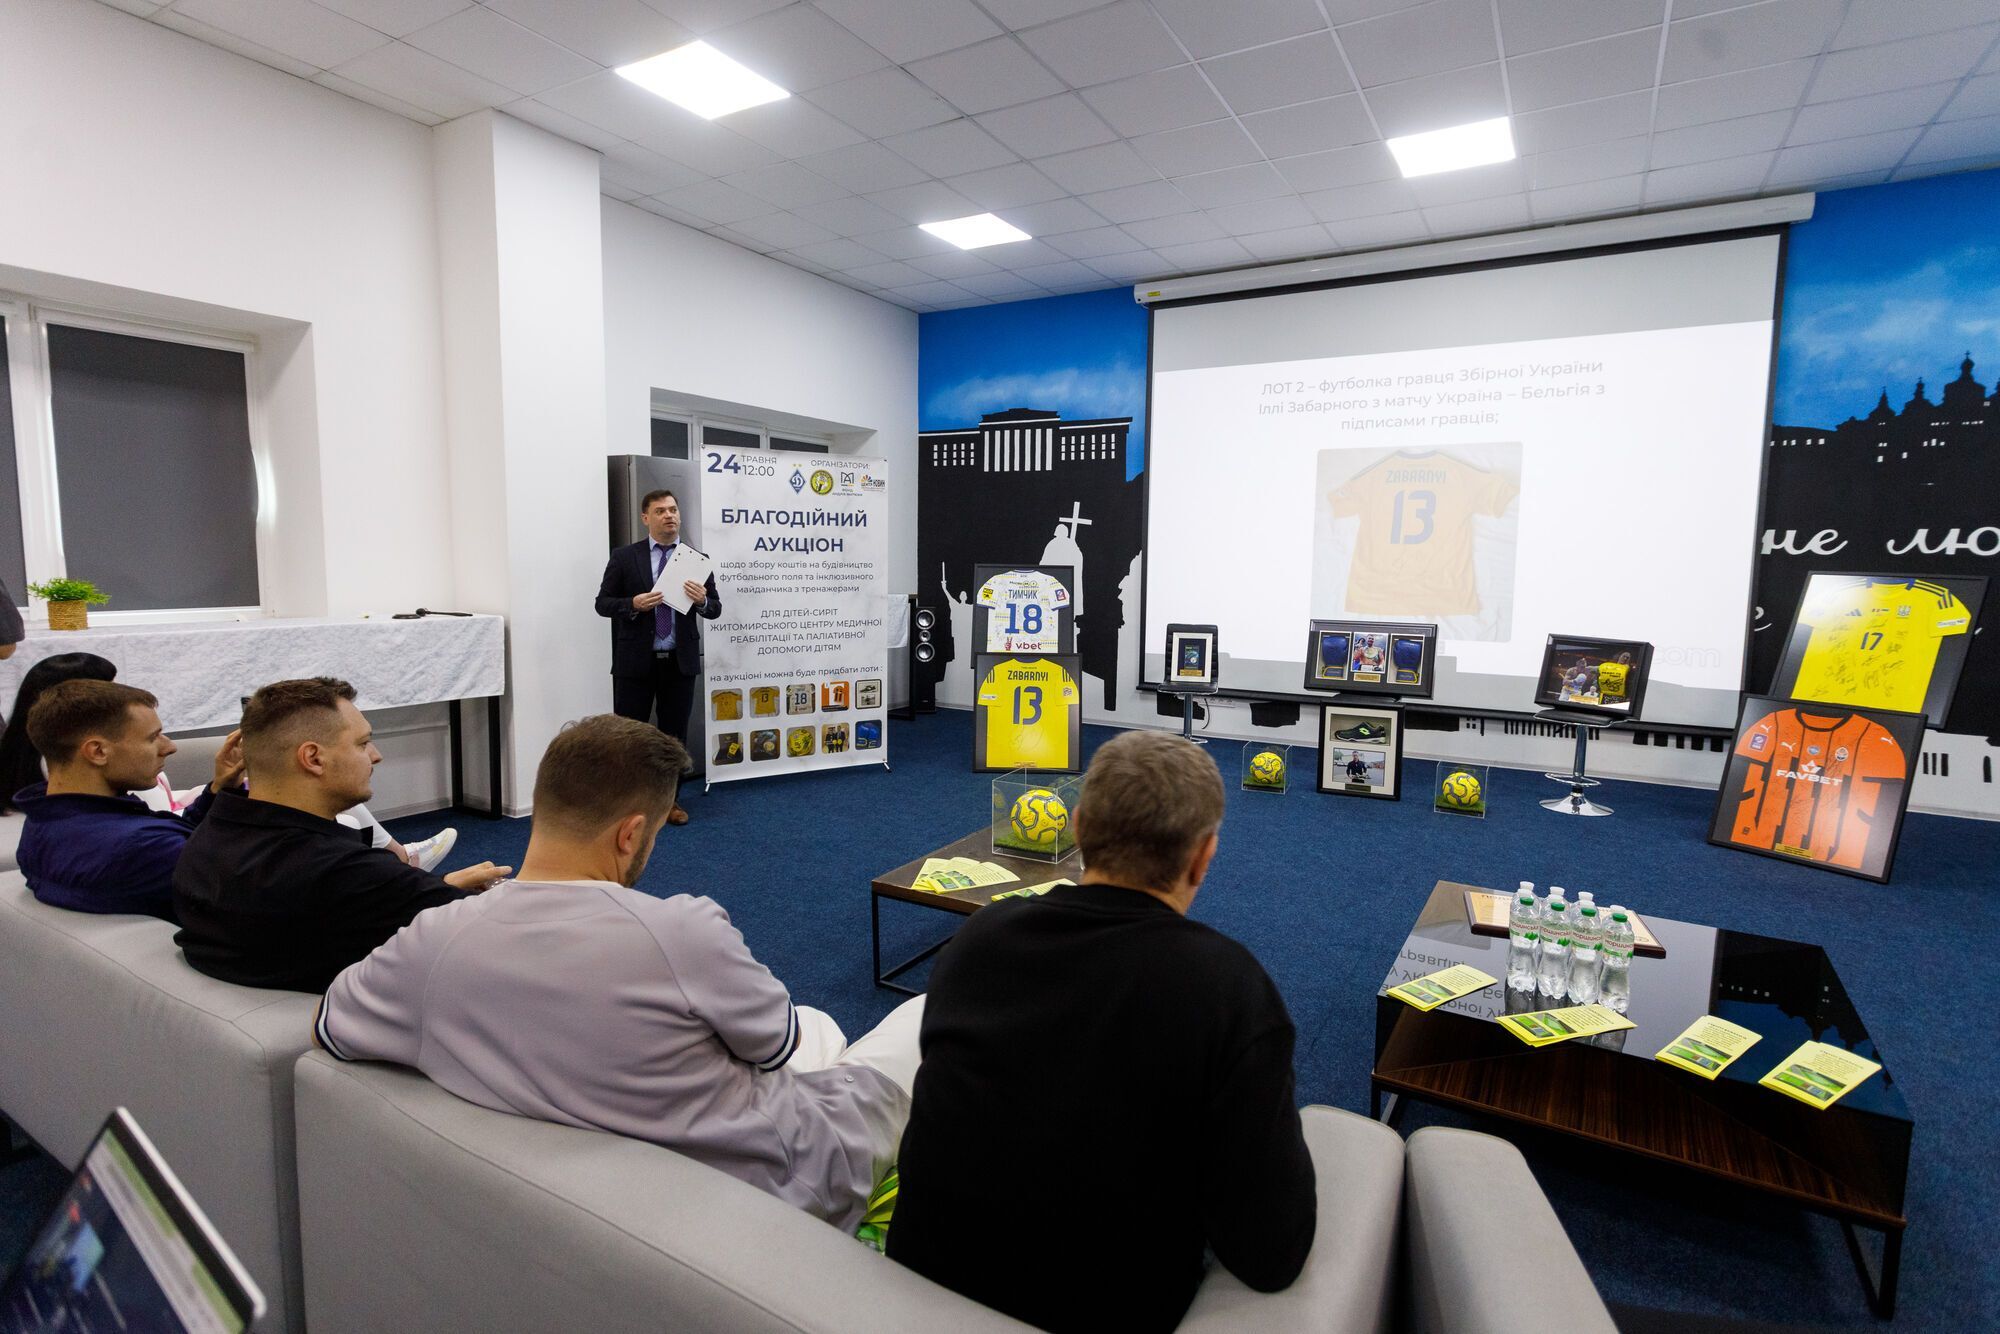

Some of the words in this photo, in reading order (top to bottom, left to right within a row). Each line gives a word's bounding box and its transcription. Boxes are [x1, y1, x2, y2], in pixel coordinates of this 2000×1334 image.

[1261, 382, 1292, 396] ЛОТ
[1296, 382, 1304, 392] 2
[1319, 375, 1392, 394] футболка
[1396, 371, 1454, 388] гравця
[1458, 366, 1524, 384] Збірної
[1529, 361, 1604, 379] України
[1258, 402, 1284, 416] Іллі
[1288, 396, 1368, 416] Забарного
[1372, 398, 1380, 409] з
[1385, 394, 1432, 411] матчу
[1436, 388, 1502, 407] Україна
[1522, 384, 1590, 400] Бельгія
[1596, 385, 1606, 396] з
[1340, 415, 1426, 432] підписами
[1430, 411, 1500, 428] гравців;
[707, 452, 740, 474] 24
[741, 455, 776, 464] ТРАВНЯ
[810, 460, 870, 470] ОРГАНІЗАТОРИ:
[742, 464, 774, 476] 12:00
[1385, 469, 1446, 485] ZABARNYI
[721, 508, 868, 528] БЛАГОДІЙНИЙ
[1390, 490, 1436, 545] 13
[754, 537, 844, 554] АУКЦІОН
[748, 560, 775, 570] збору
[778, 560, 807, 569] коштів
[822, 560, 874, 570] будівництво
[720, 572, 780, 582] футбольного
[816, 572, 874, 580] інклюзивного
[736, 586, 792, 594] майданчика
[802, 586, 860, 594] тренажерами
[1008, 589, 1038, 600] ТИМЧИК
[761, 610, 780, 618] ДЛЯ
[783, 608, 838, 618] ДІТЕЙ-СИРІТ
[1005, 604, 1042, 634] 18
[710, 622, 798, 632] ЖИТОМИРСЬКОГО
[800, 620, 834, 630] ЦЕНТРУ
[836, 618, 882, 628] МЕДИЧНОЇ
[730, 634, 790, 643] РЕАБІЛІТАЦІЇ
[806, 630, 866, 640] ПАЛІАТИВНОЇ
[1860, 632, 1884, 650] 17
[758, 646, 812, 656] ДОПОМОГИ
[814, 644, 842, 653] ДІТЯМ
[724, 672, 762, 682] аукціоні
[796, 669, 816, 678] буде
[818, 667, 858, 676] придбати
[1008, 670, 1048, 681] ZABARNYI
[795, 693, 808, 705] 18
[1013, 686, 1042, 725] 13
[1776, 769, 1842, 786] FAVBET
